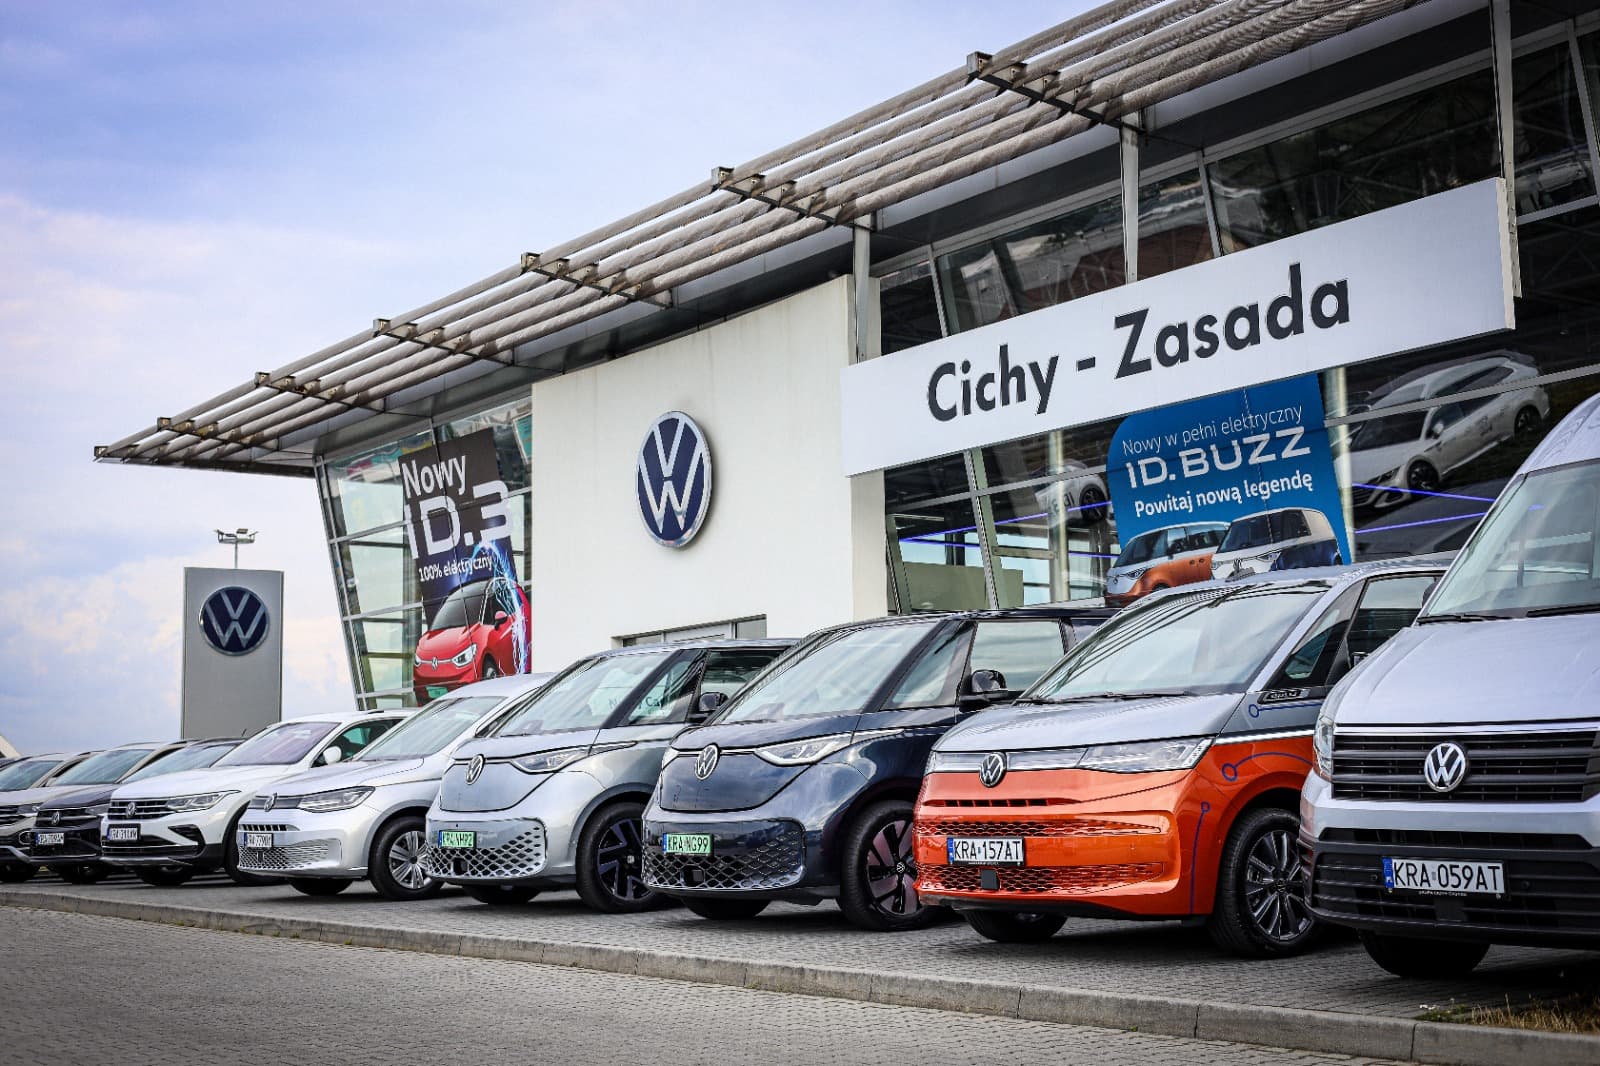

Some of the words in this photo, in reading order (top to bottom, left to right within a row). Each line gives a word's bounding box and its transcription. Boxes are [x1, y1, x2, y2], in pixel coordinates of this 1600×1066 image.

[927, 343, 1060, 423] Cichy
[1114, 262, 1350, 380] Zasada
[1122, 436, 1162, 456] Nowy
[1166, 433, 1178, 447] w
[1183, 420, 1217, 447] pełni
[1221, 405, 1302, 435] elektryczny
[402, 455, 466, 499] Nowy
[1135, 491, 1193, 518] Powitaj
[1196, 484, 1243, 507] nową
[1243, 470, 1314, 500] legendę
[404, 480, 513, 559] ID.3
[419, 563, 442, 582] 100%
[443, 555, 494, 577] elektryczny
[668, 836, 684, 851] KRA
[954, 841, 977, 860] KRA
[982, 841, 1020, 860] 157AT
[1393, 862, 1431, 887] KRA
[1437, 863, 1501, 890] 059AT
